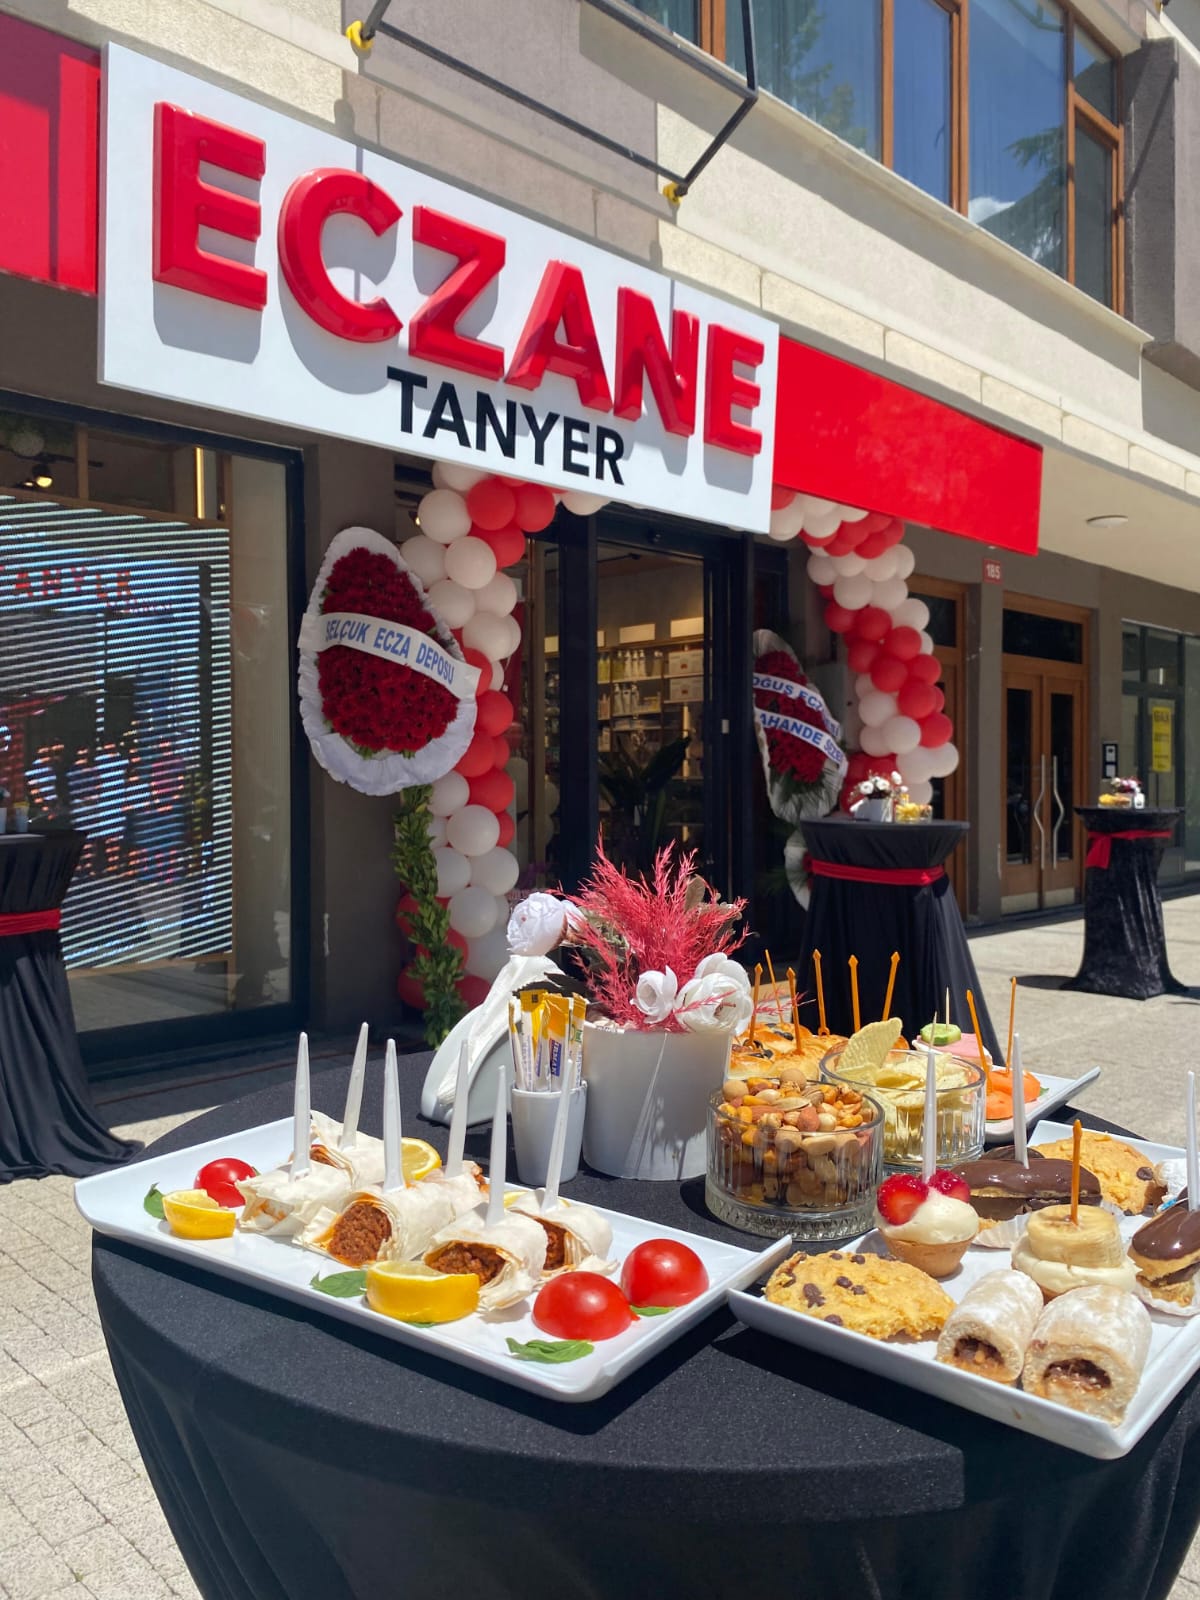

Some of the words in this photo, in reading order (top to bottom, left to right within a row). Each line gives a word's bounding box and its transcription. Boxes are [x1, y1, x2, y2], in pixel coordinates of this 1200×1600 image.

[153, 101, 764, 456] ECZANE
[386, 367, 625, 485] TANYER
[986, 564, 1001, 580] 185
[373, 627, 411, 658] ECZA
[416, 643, 455, 685] DEPOSU
